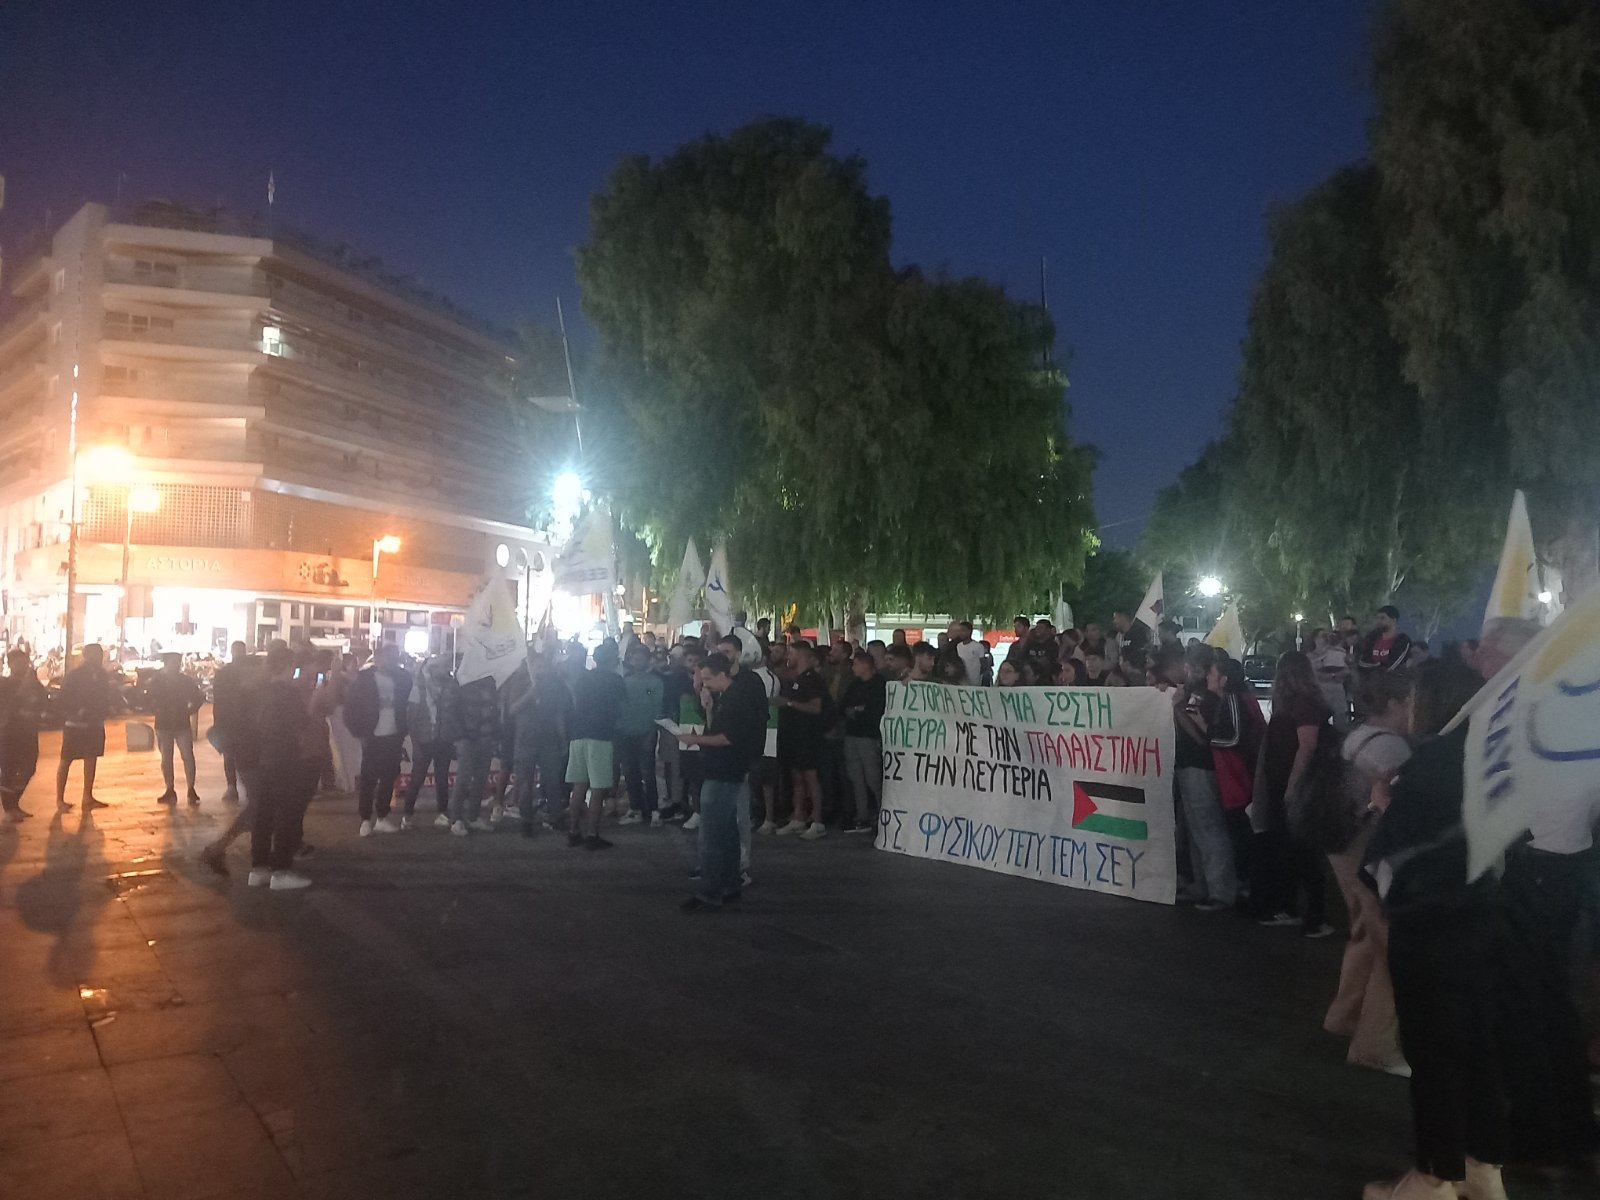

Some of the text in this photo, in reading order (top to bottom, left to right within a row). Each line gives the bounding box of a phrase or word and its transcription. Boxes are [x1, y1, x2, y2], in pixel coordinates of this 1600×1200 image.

[887, 684, 1113, 729] Η ΙΣΤΟΡΙΑ ΕΧΕΙ ΜΙΑ ΣΩΣΤΗ
[884, 716, 1162, 778] ΠΛΕΥΡΑ ΜΕ ΤΗΝ ΠΑΛΑΙΣΤΙΝΗ
[914, 752, 957, 787] ΤΗΝ
[963, 760, 1052, 802] ΛΕΥΤΕΡΙΑ
[1096, 843, 1145, 889] ΣΕΥ
